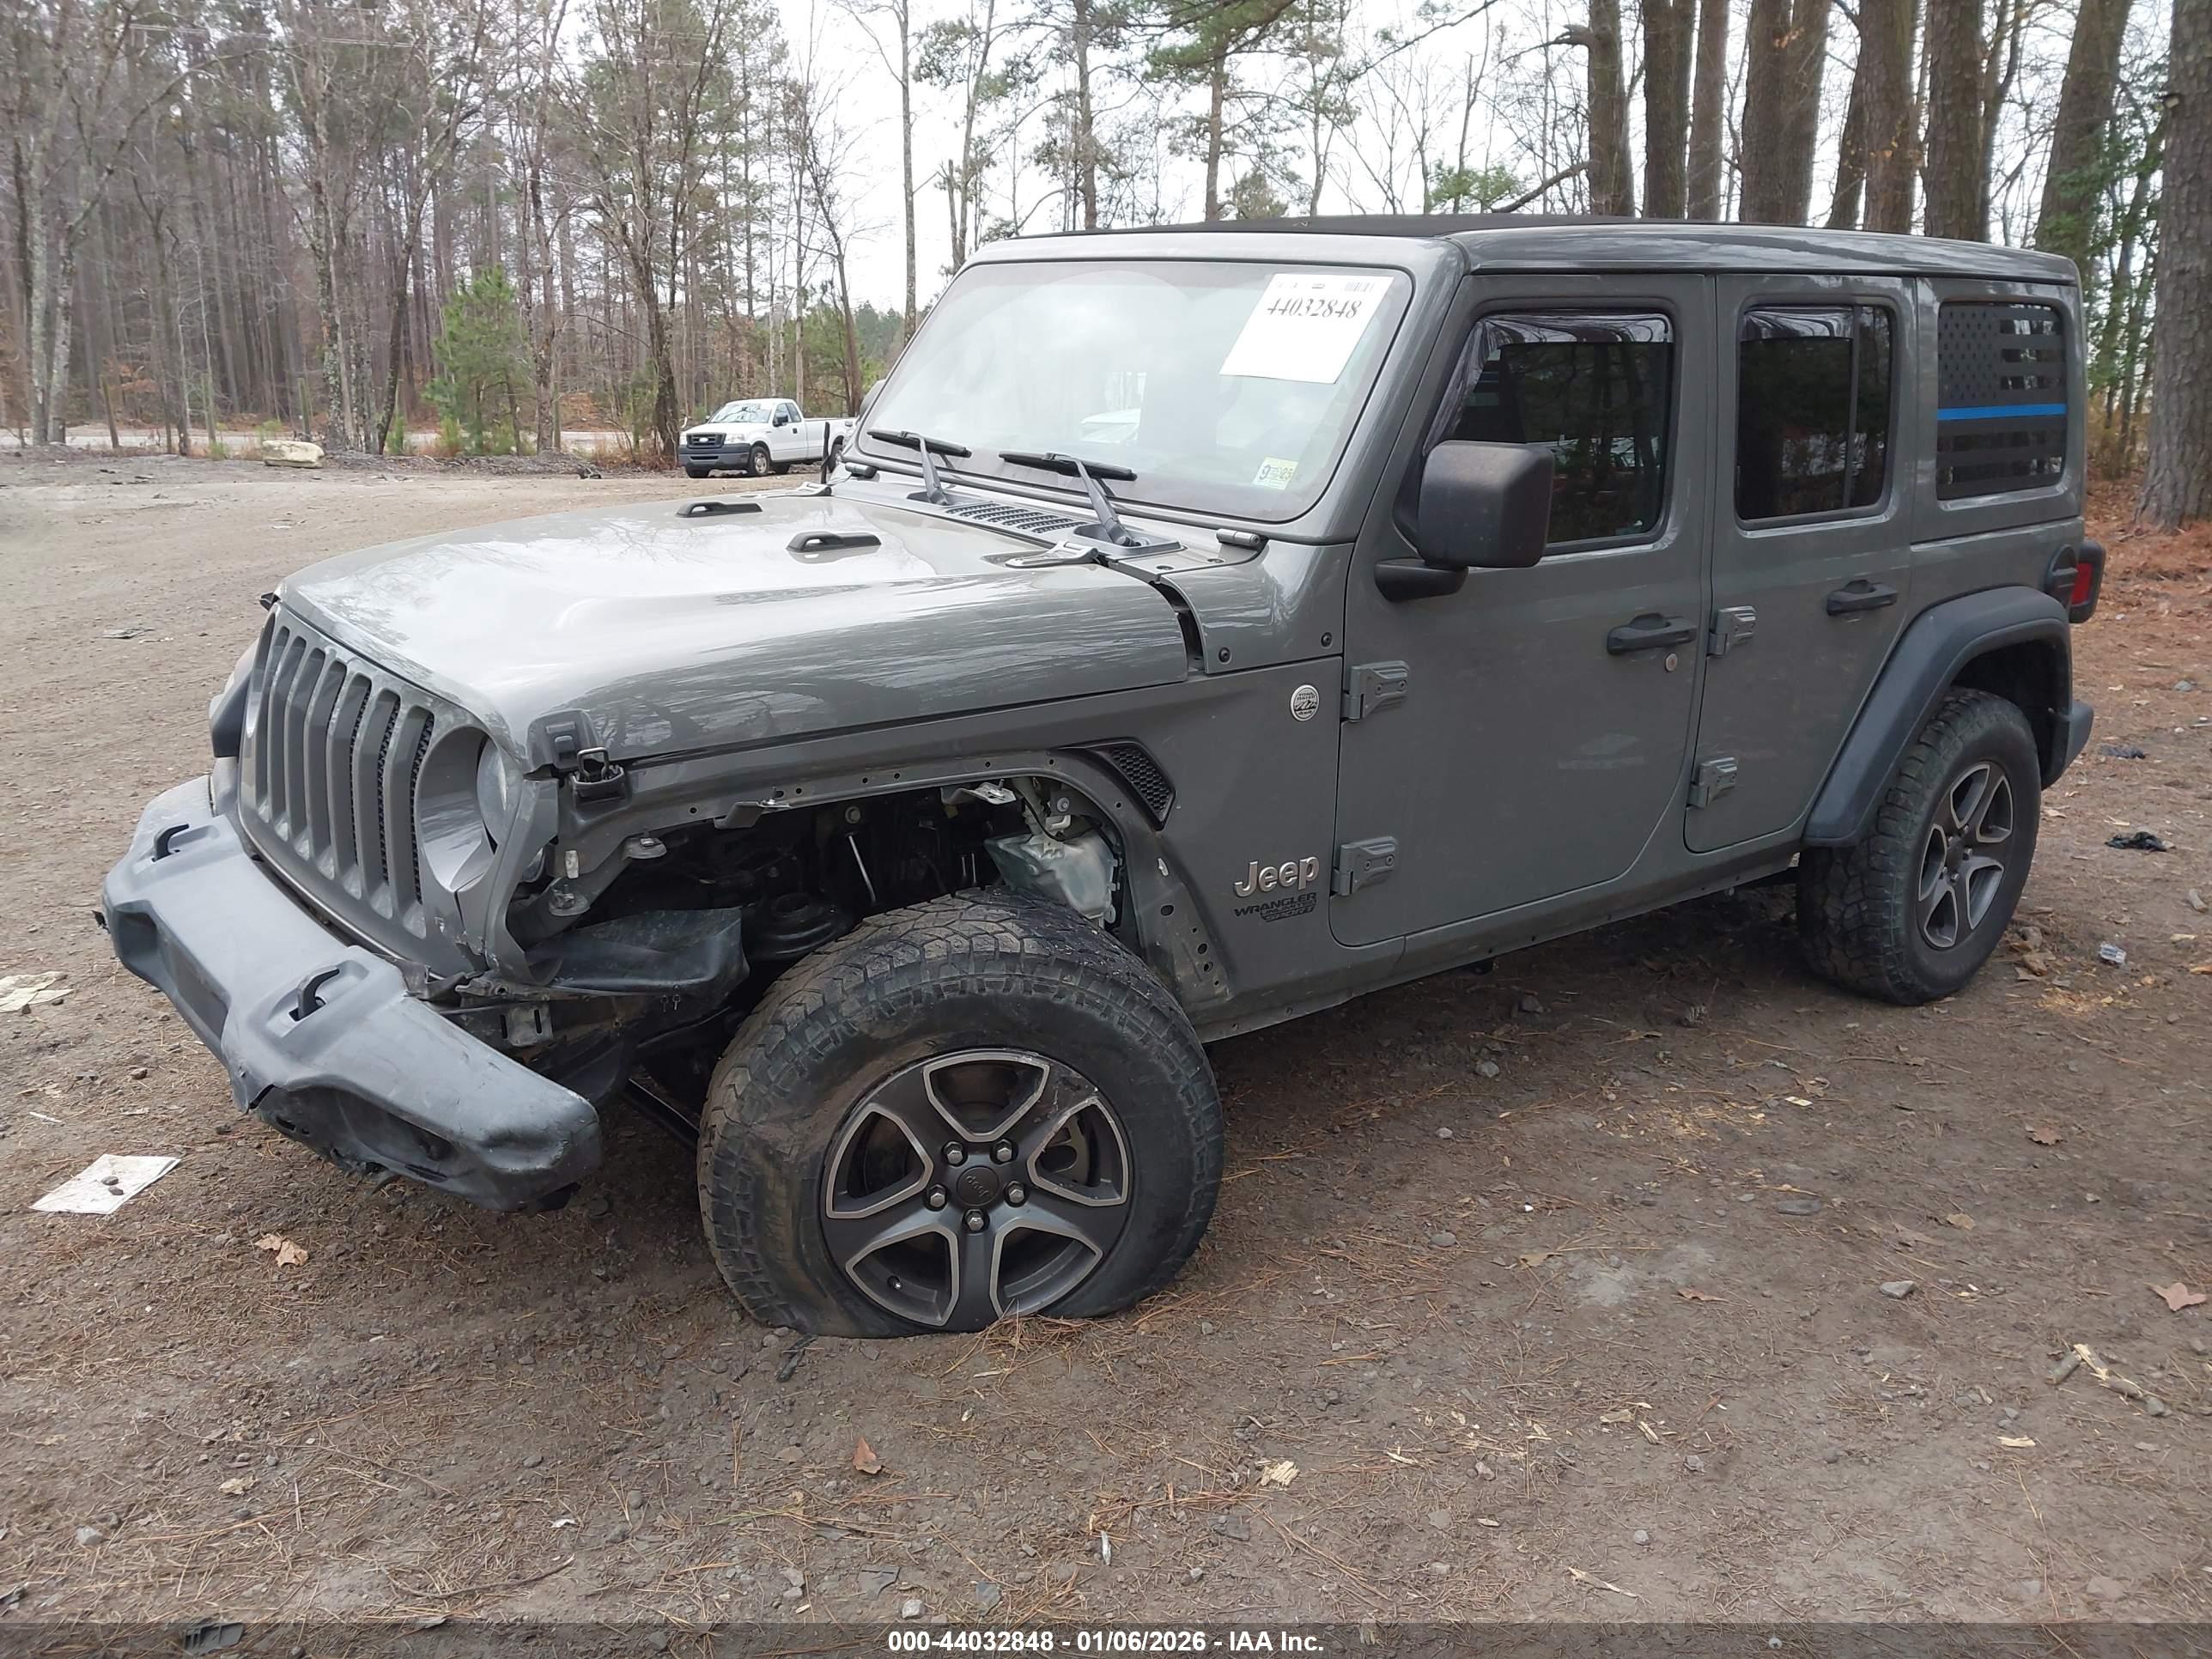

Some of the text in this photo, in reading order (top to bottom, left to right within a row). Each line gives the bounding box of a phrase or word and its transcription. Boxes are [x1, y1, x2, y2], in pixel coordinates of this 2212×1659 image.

[1267, 297, 1363, 319] 44032848
[1233, 856, 1320, 897] Jeep
[1234, 892, 1316, 916] WRANGLER
